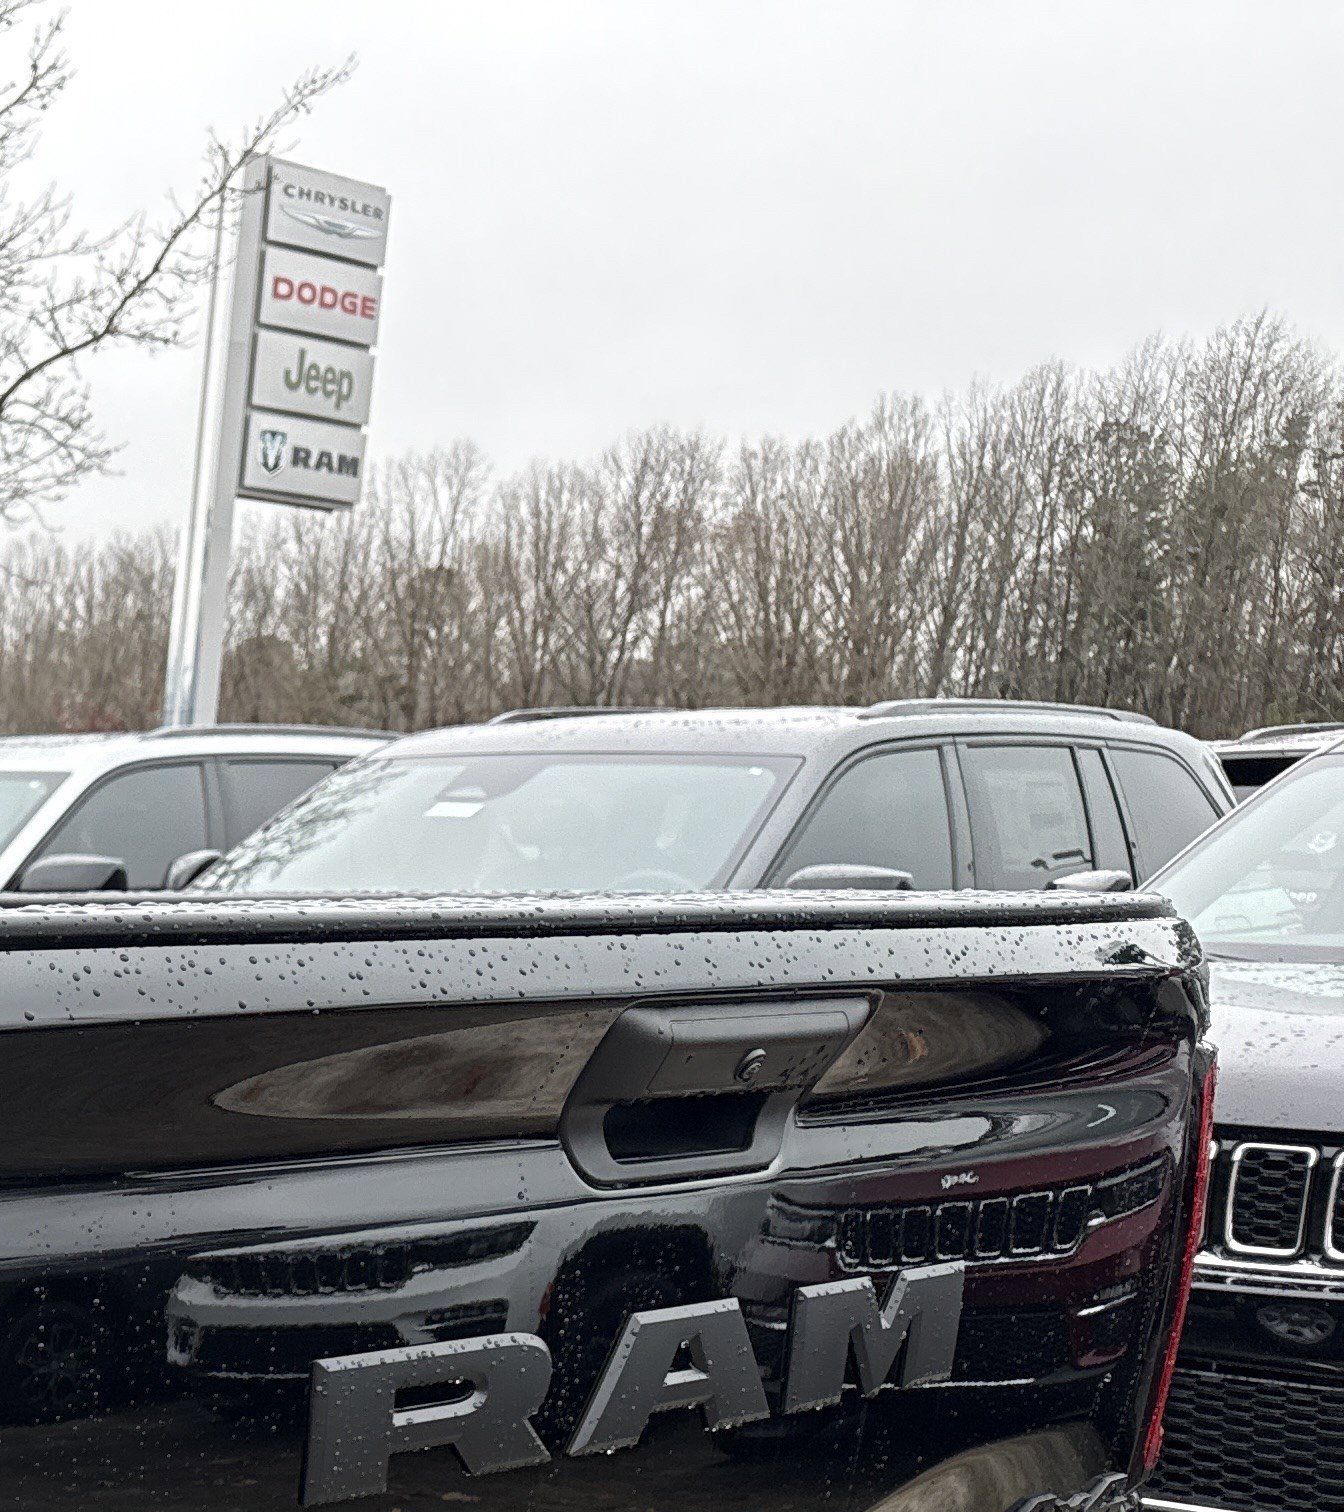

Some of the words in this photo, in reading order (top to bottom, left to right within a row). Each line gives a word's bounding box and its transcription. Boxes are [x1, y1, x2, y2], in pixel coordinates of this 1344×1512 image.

[283, 183, 384, 221] CHRYSLER
[272, 274, 377, 321] DODGE
[284, 347, 354, 411] Jeep
[291, 446, 360, 479] RAM
[301, 1260, 965, 1507] RAM
